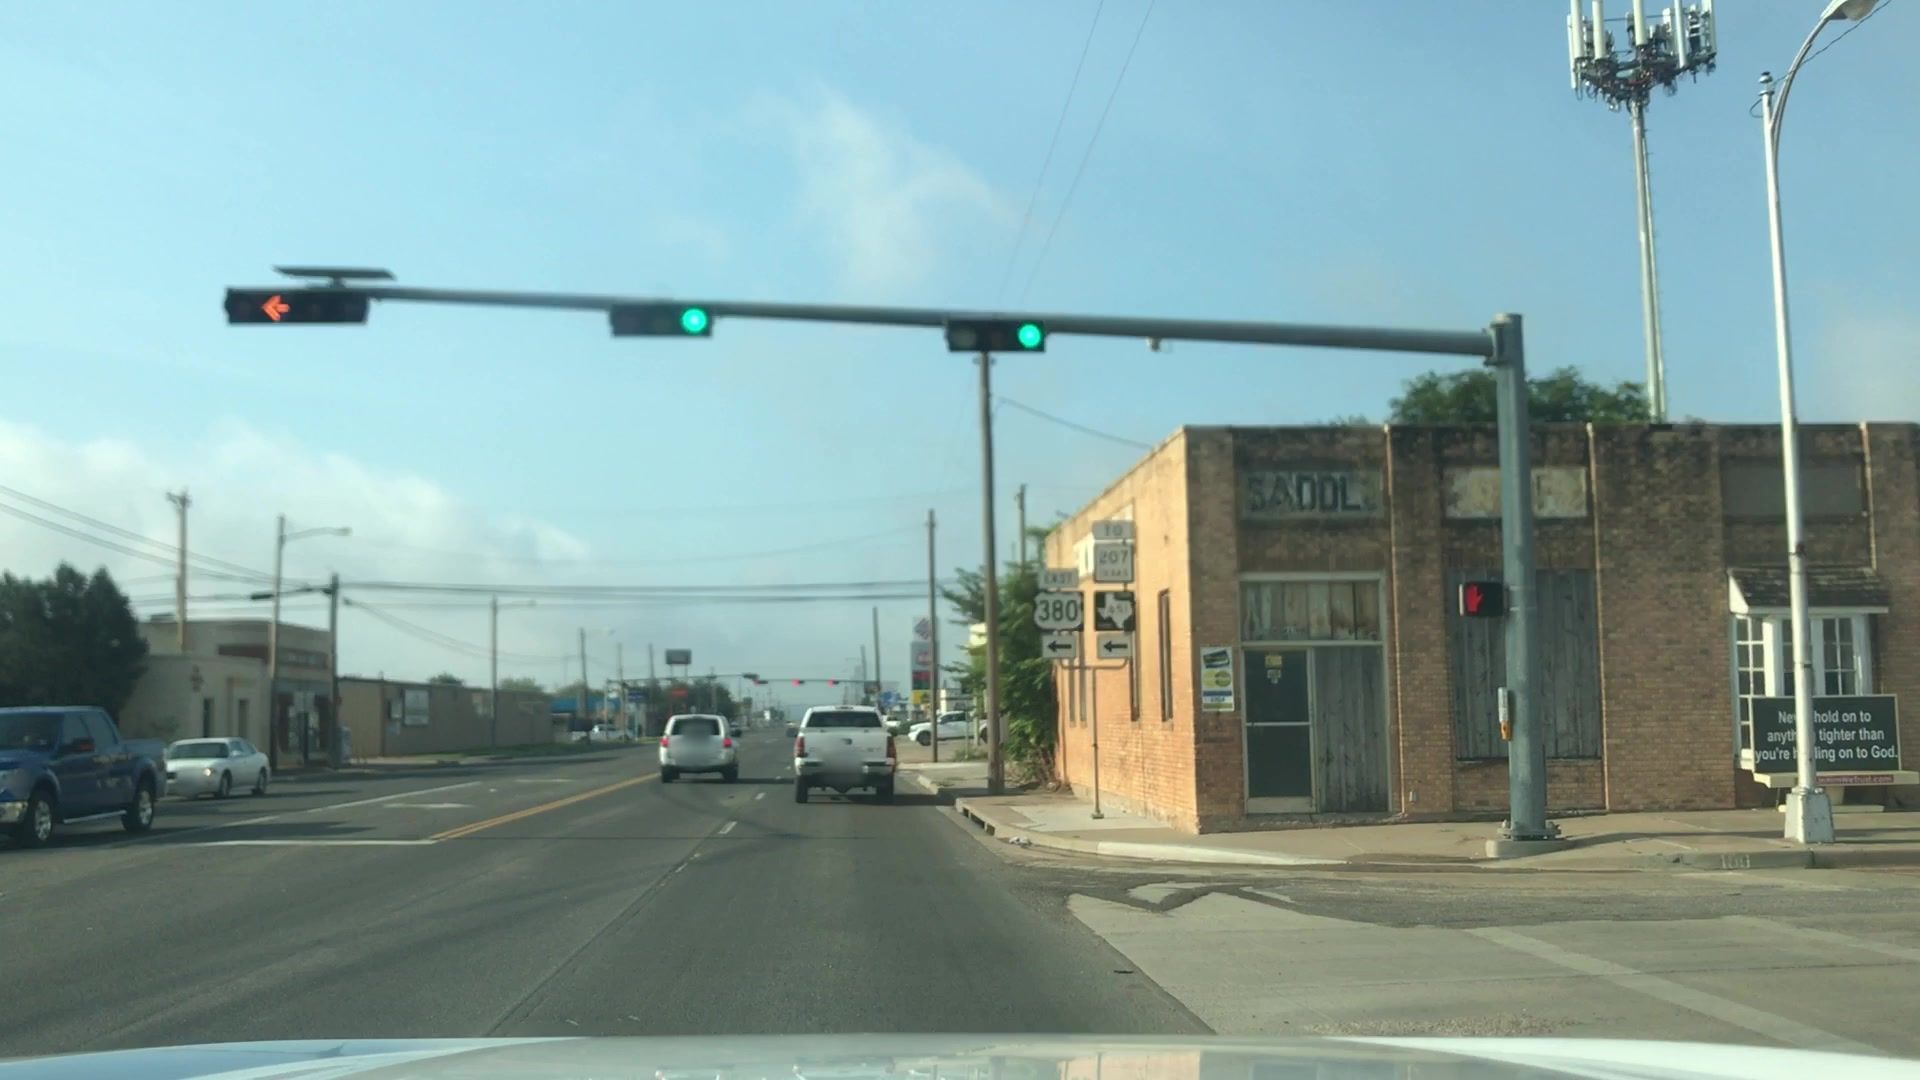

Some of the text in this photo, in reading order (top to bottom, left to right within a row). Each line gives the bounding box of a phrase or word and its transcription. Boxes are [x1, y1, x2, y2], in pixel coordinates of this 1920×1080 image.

[1099, 550, 1129, 564] 207
[1039, 599, 1078, 622] 380
[1814, 710, 1839, 723] hold
[1842, 712, 1857, 723] on
[1860, 711, 1872, 723] to
[1819, 728, 1856, 744] tighter
[1859, 728, 1885, 741] than
[1755, 747, 1790, 764] you're
[1839, 749, 1853, 759] on
[1856, 747, 1868, 759] to
[1871, 745, 1899, 759] God.
